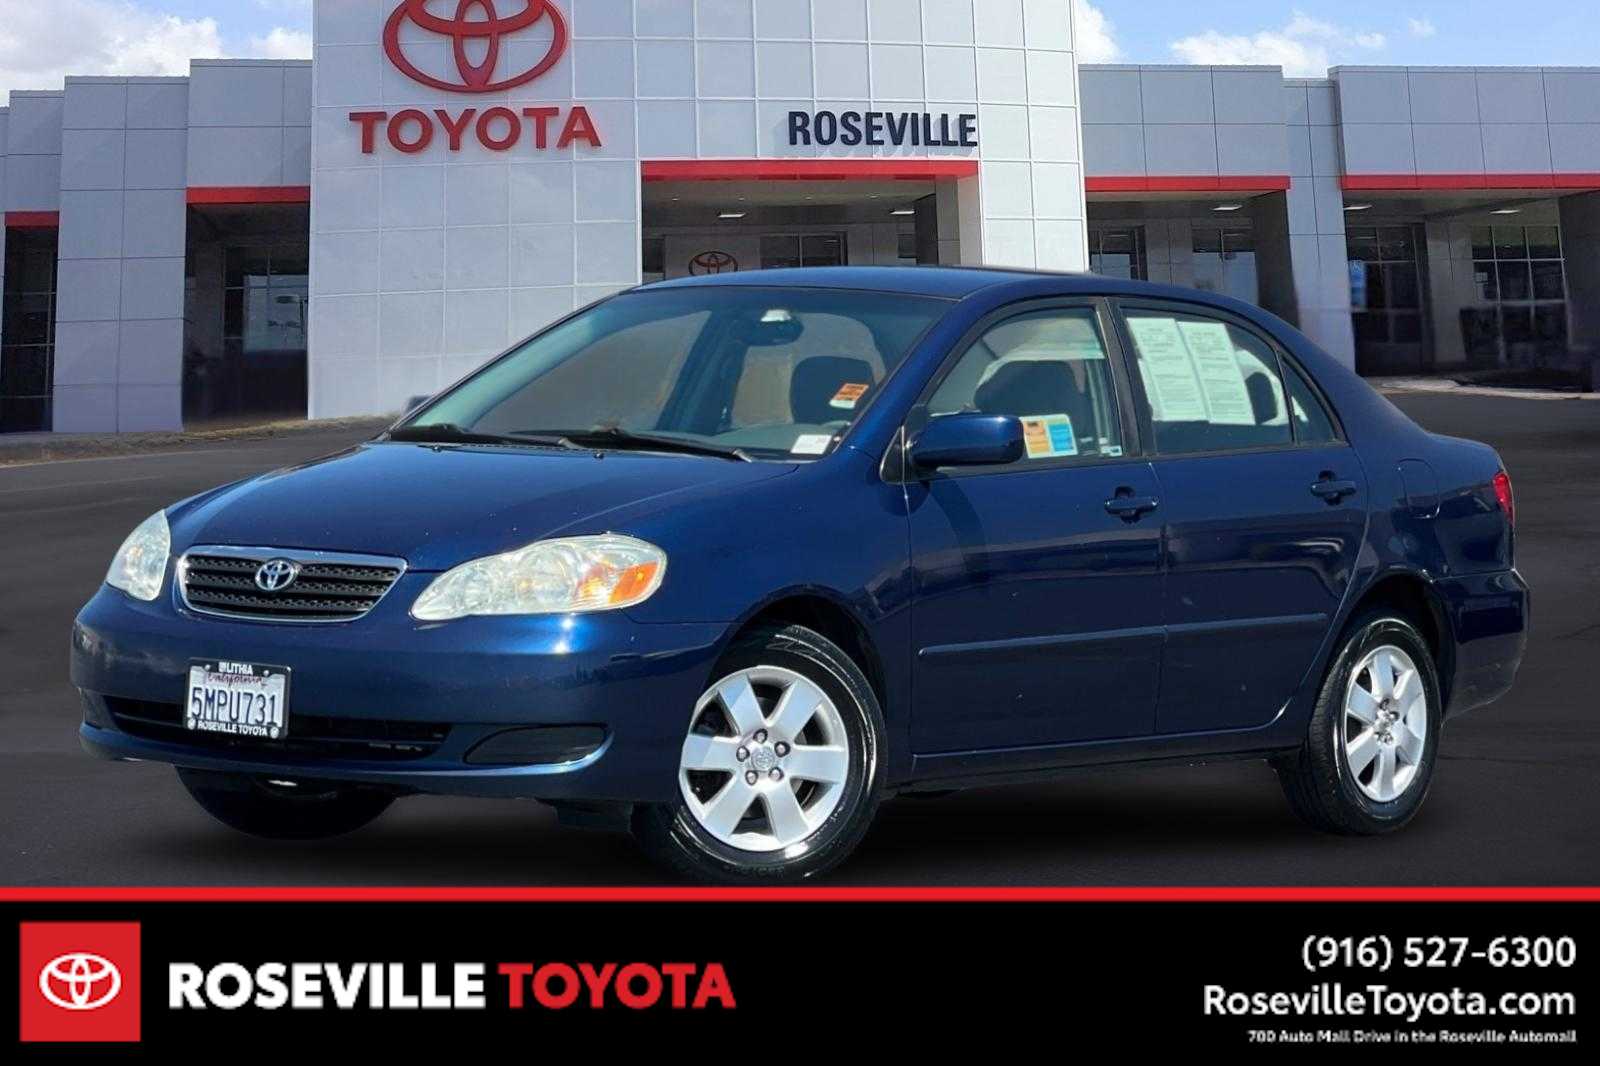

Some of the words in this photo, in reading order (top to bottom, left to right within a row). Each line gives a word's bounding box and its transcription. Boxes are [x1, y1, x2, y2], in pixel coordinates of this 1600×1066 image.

[349, 106, 602, 154] TOYOTA
[788, 111, 978, 148] ROSEVILLE
[191, 686, 276, 725] 5MPU731
[197, 720, 237, 734] ROSEVILLE
[239, 723, 268, 737] TOYOTA
